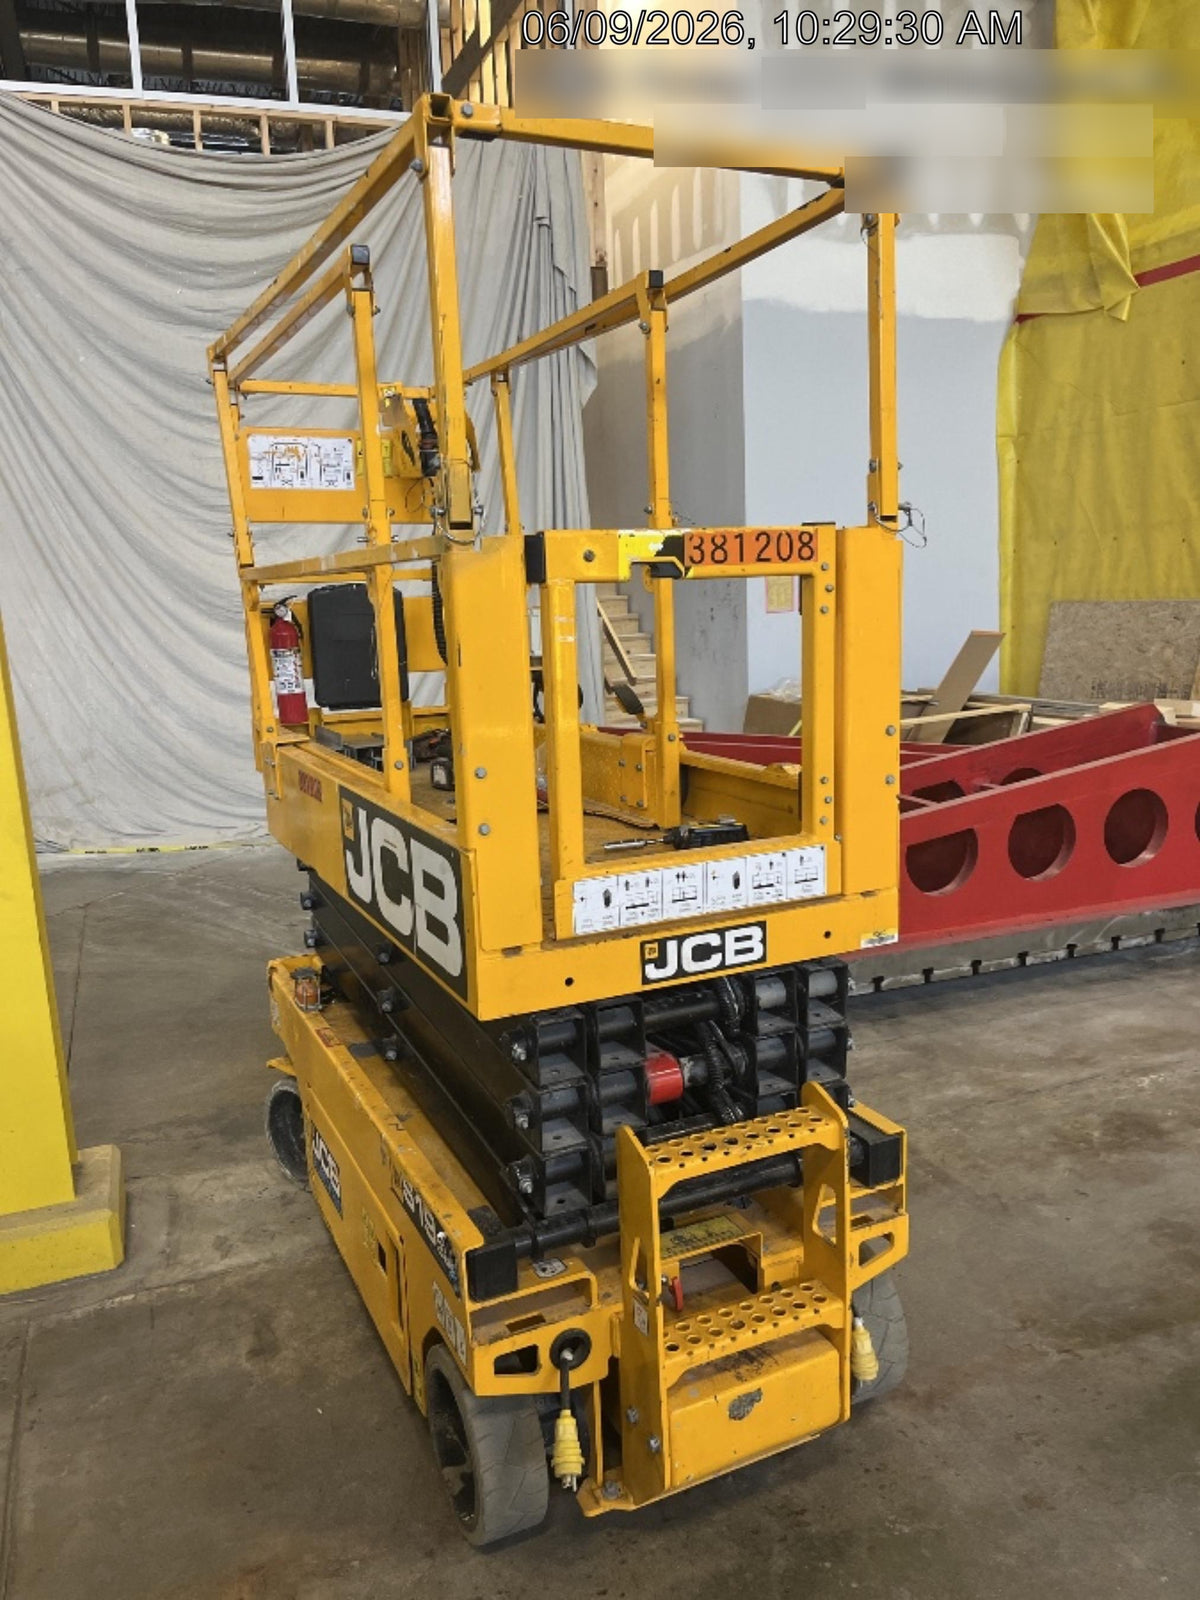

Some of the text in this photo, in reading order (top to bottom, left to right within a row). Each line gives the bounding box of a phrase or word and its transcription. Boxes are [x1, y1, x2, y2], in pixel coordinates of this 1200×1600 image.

[689, 531, 814, 564] 381208
[345, 806, 463, 977] JCB
[644, 925, 764, 979] JCB
[312, 1130, 341, 1198] JCB
